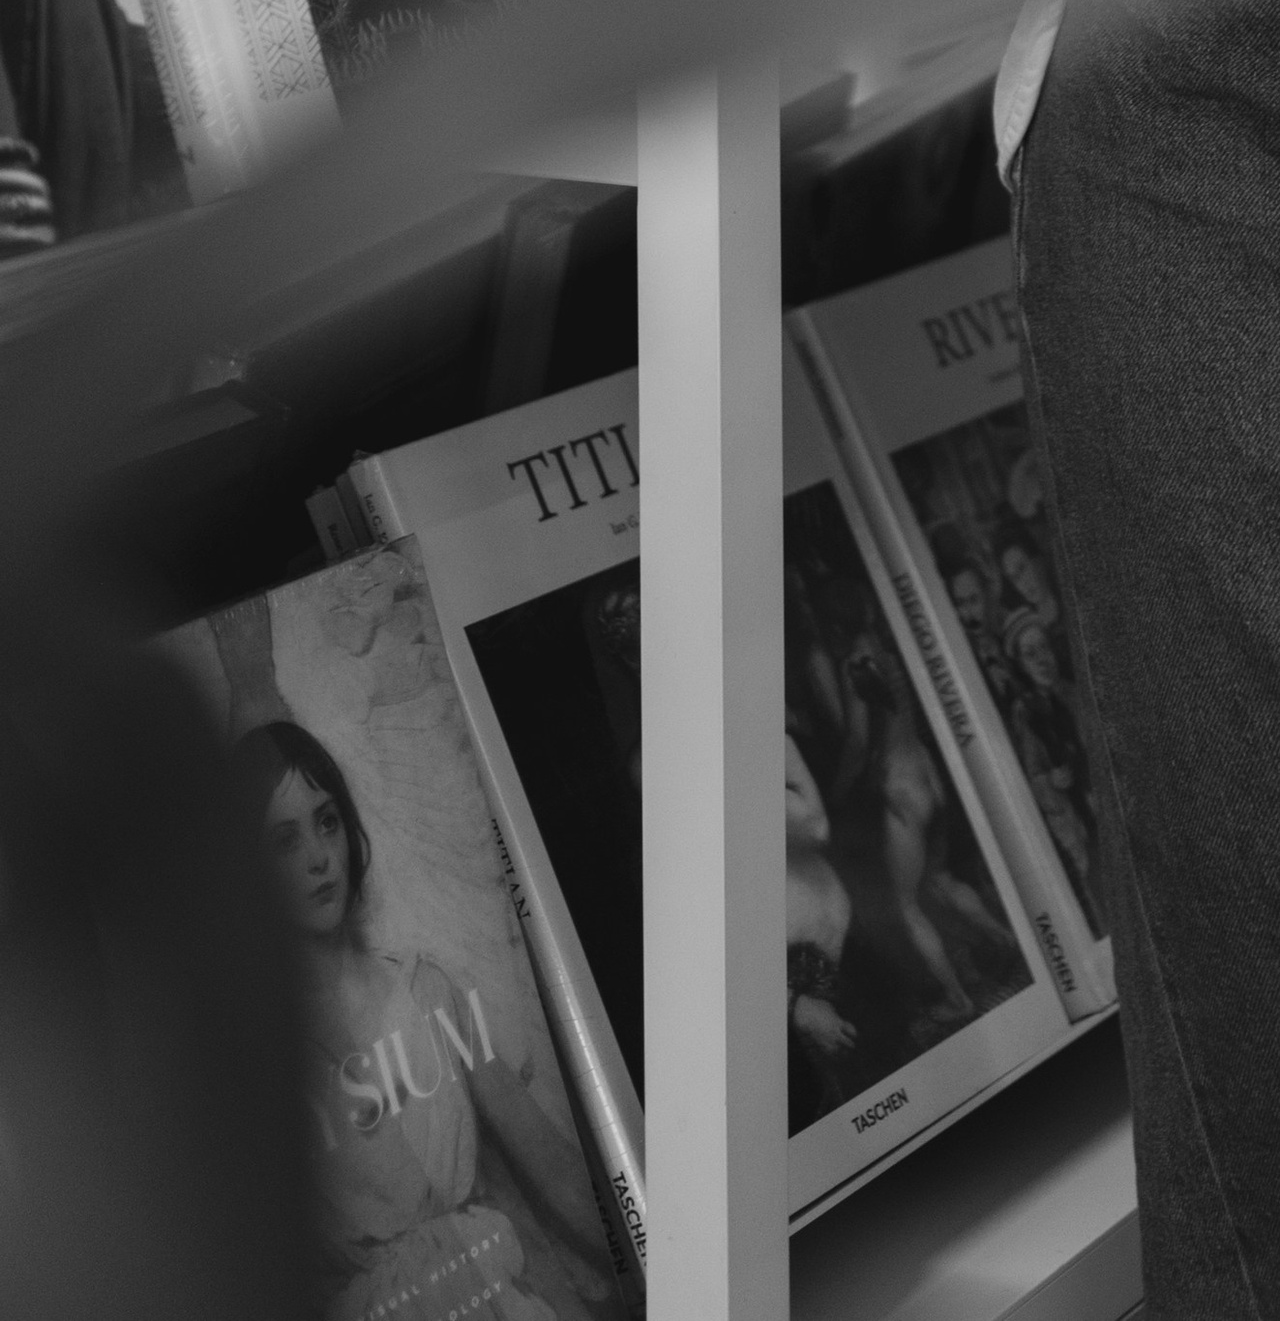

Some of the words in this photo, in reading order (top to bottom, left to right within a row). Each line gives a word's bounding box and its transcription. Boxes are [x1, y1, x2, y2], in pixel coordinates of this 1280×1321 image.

[1036, 912, 1077, 994] TASCHEN
[851, 1088, 911, 1134] TASCHEN
[613, 1171, 646, 1266] TASCHE
[430, 1230, 501, 1284] HISTORY
[440, 1281, 502, 1321] OLOGY
